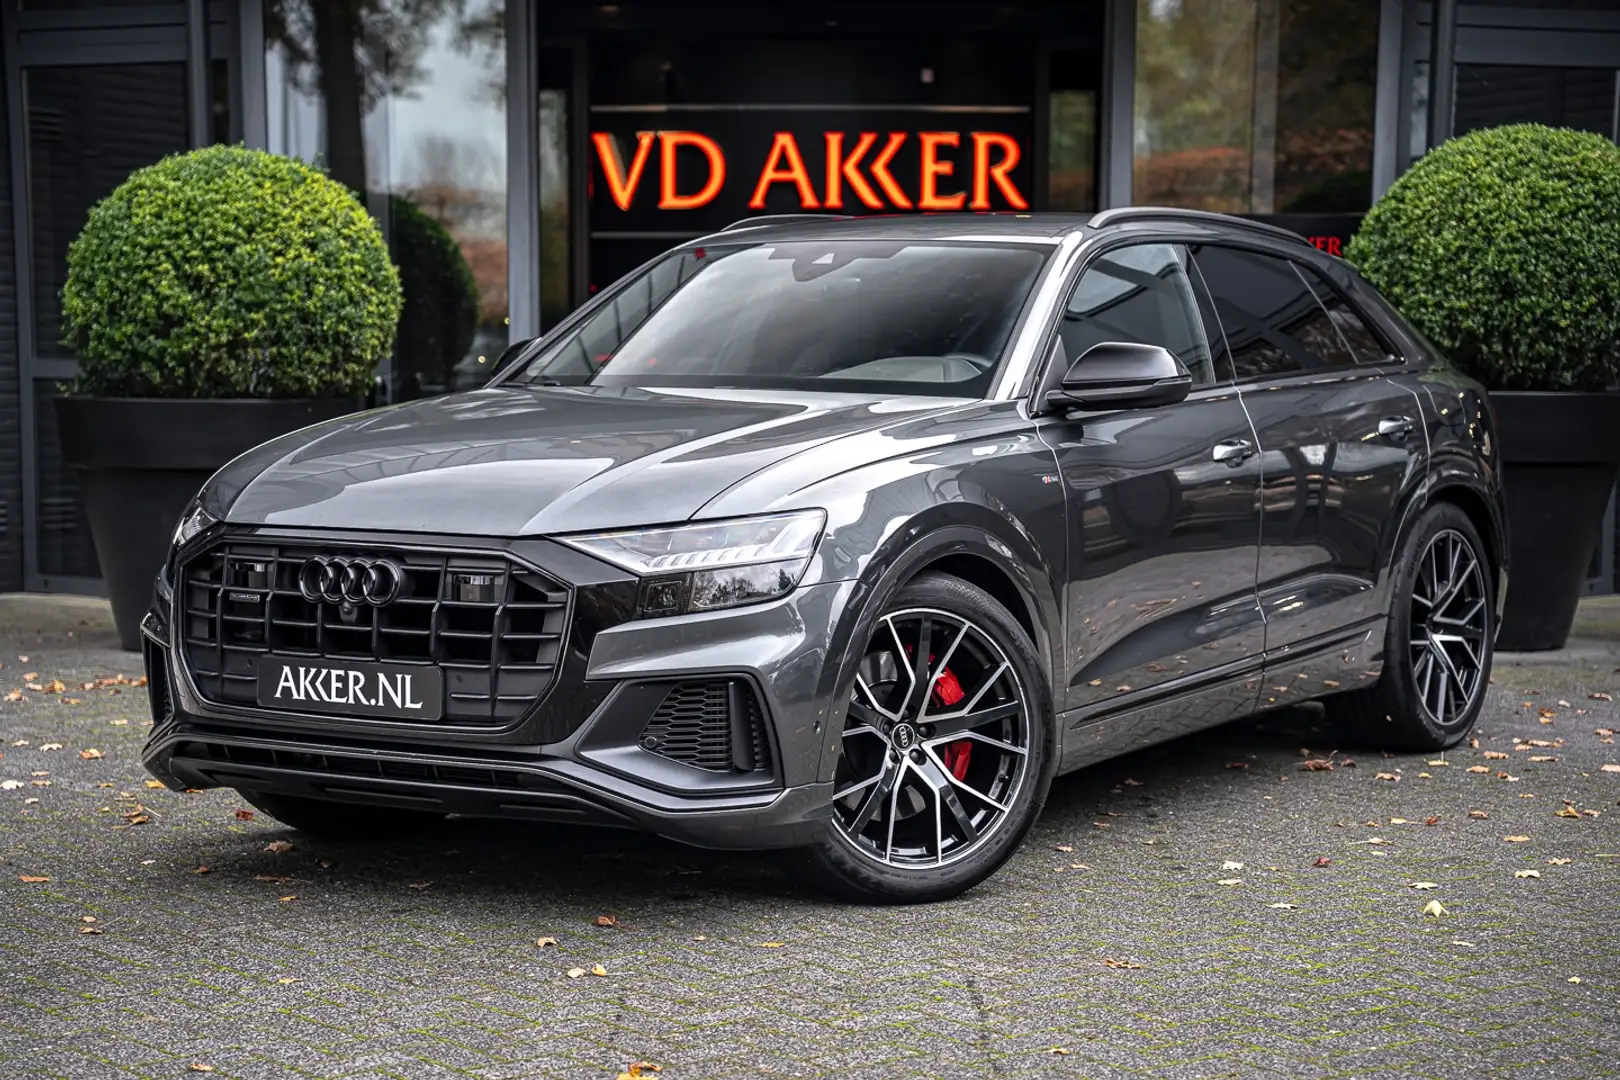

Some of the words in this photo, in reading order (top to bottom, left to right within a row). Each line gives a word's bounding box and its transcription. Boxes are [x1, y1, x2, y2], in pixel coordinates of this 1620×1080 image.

[591, 131, 727, 211] VD
[749, 131, 1029, 210] AKKER
[274, 665, 423, 709] AKKER.NL
